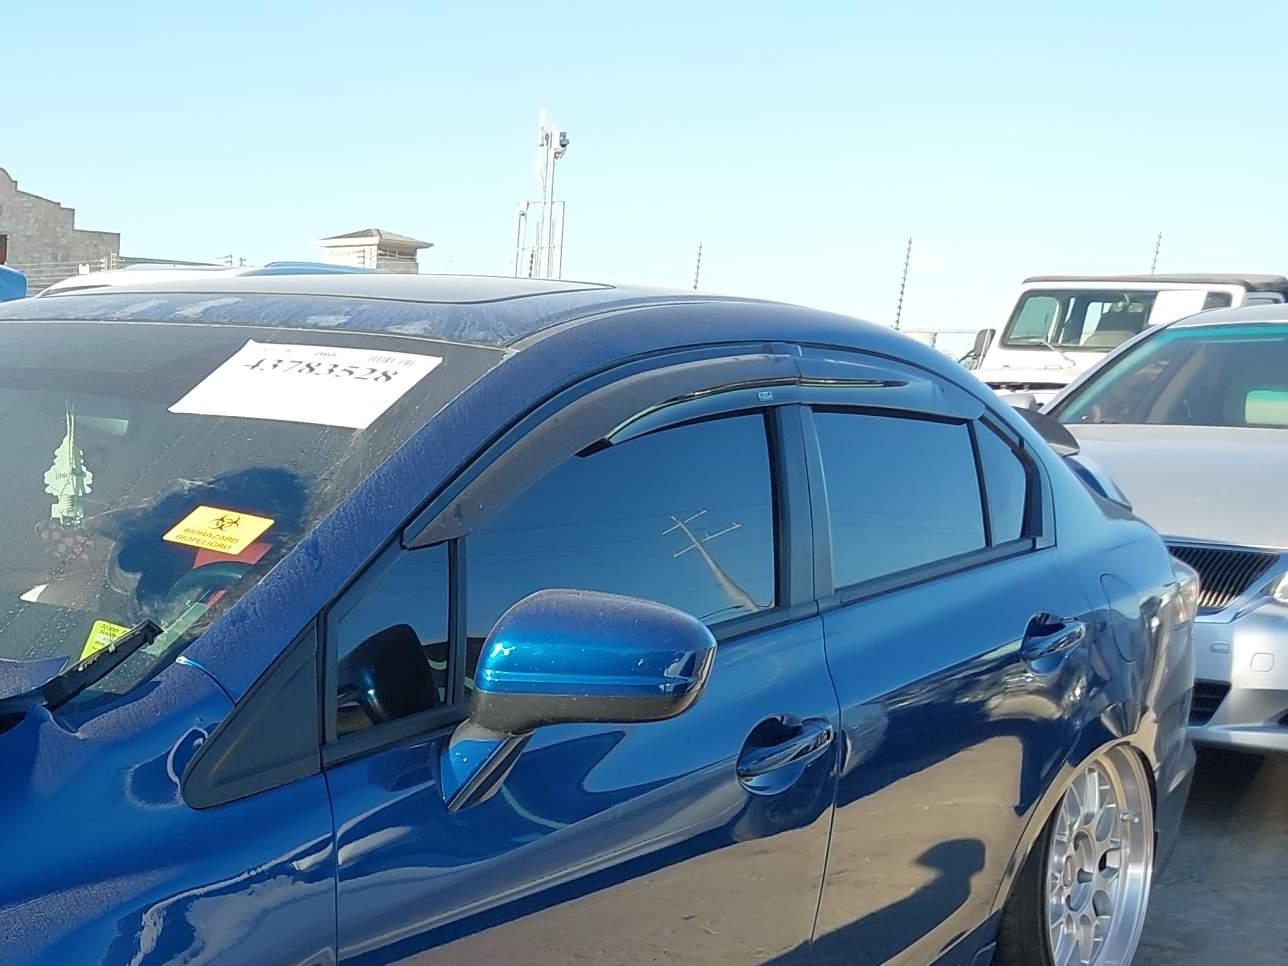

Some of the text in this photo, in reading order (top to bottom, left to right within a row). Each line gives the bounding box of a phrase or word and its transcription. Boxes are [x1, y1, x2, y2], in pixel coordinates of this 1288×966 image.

[244, 358, 399, 383] 43783528
[174, 534, 232, 550] BIOPELIGRO
[183, 527, 240, 544] BIOHAZARD
